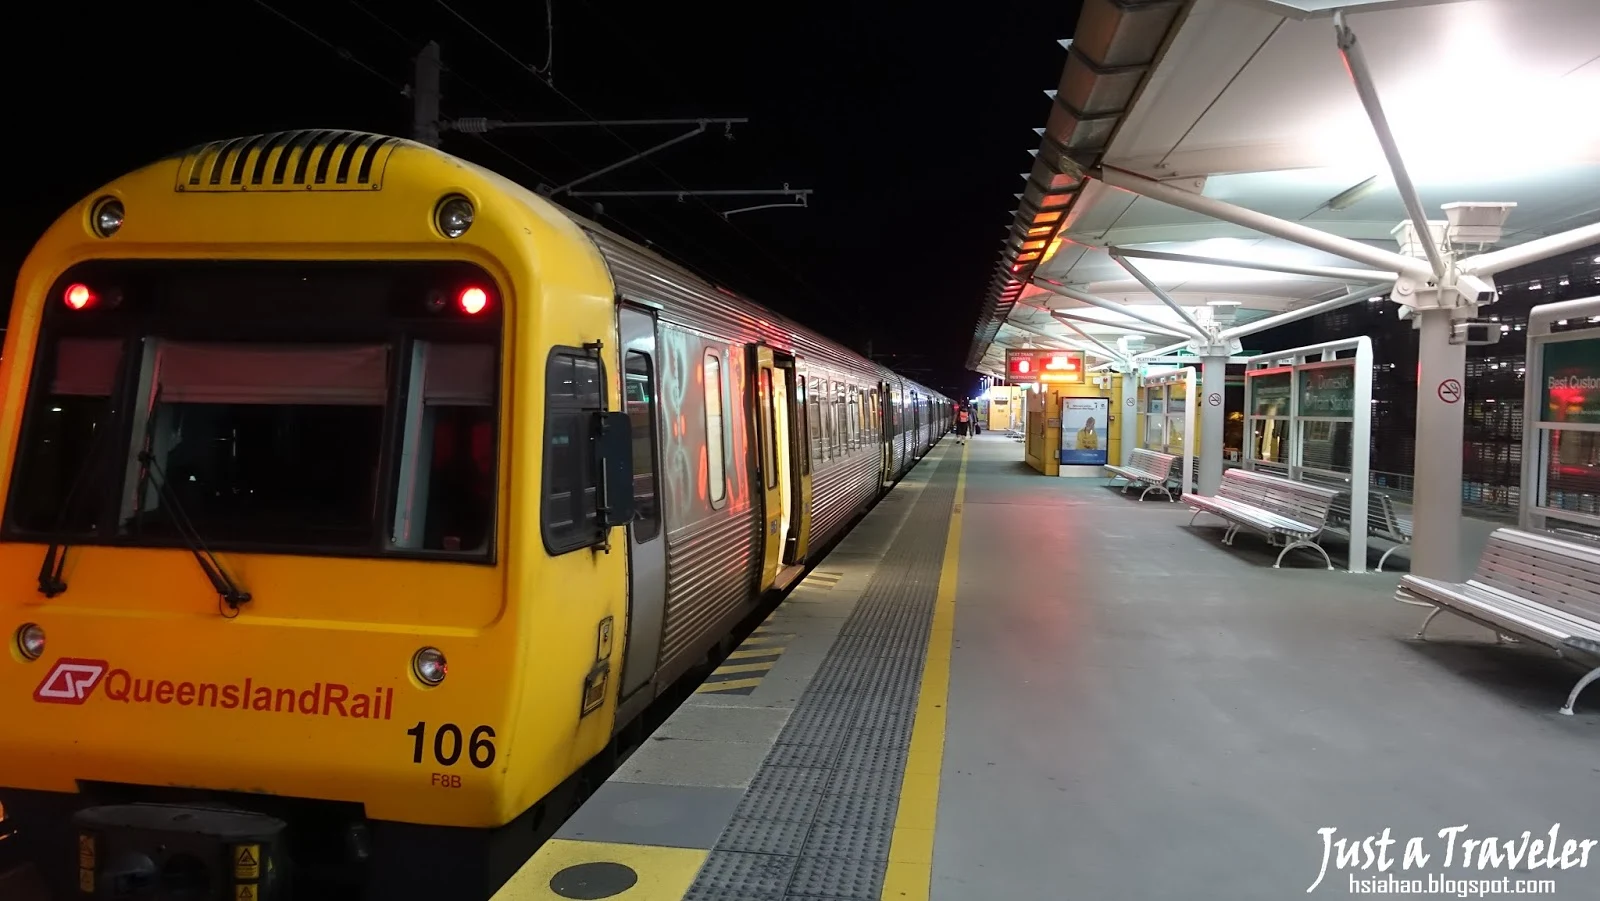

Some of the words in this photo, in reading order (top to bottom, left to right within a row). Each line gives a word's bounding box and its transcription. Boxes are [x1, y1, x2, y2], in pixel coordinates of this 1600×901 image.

[1318, 374, 1349, 389] Domestic
[1548, 376, 1568, 389] Best
[104, 668, 393, 721] QueenslandRail
[407, 721, 496, 769] 106
[431, 772, 462, 789] F8B
